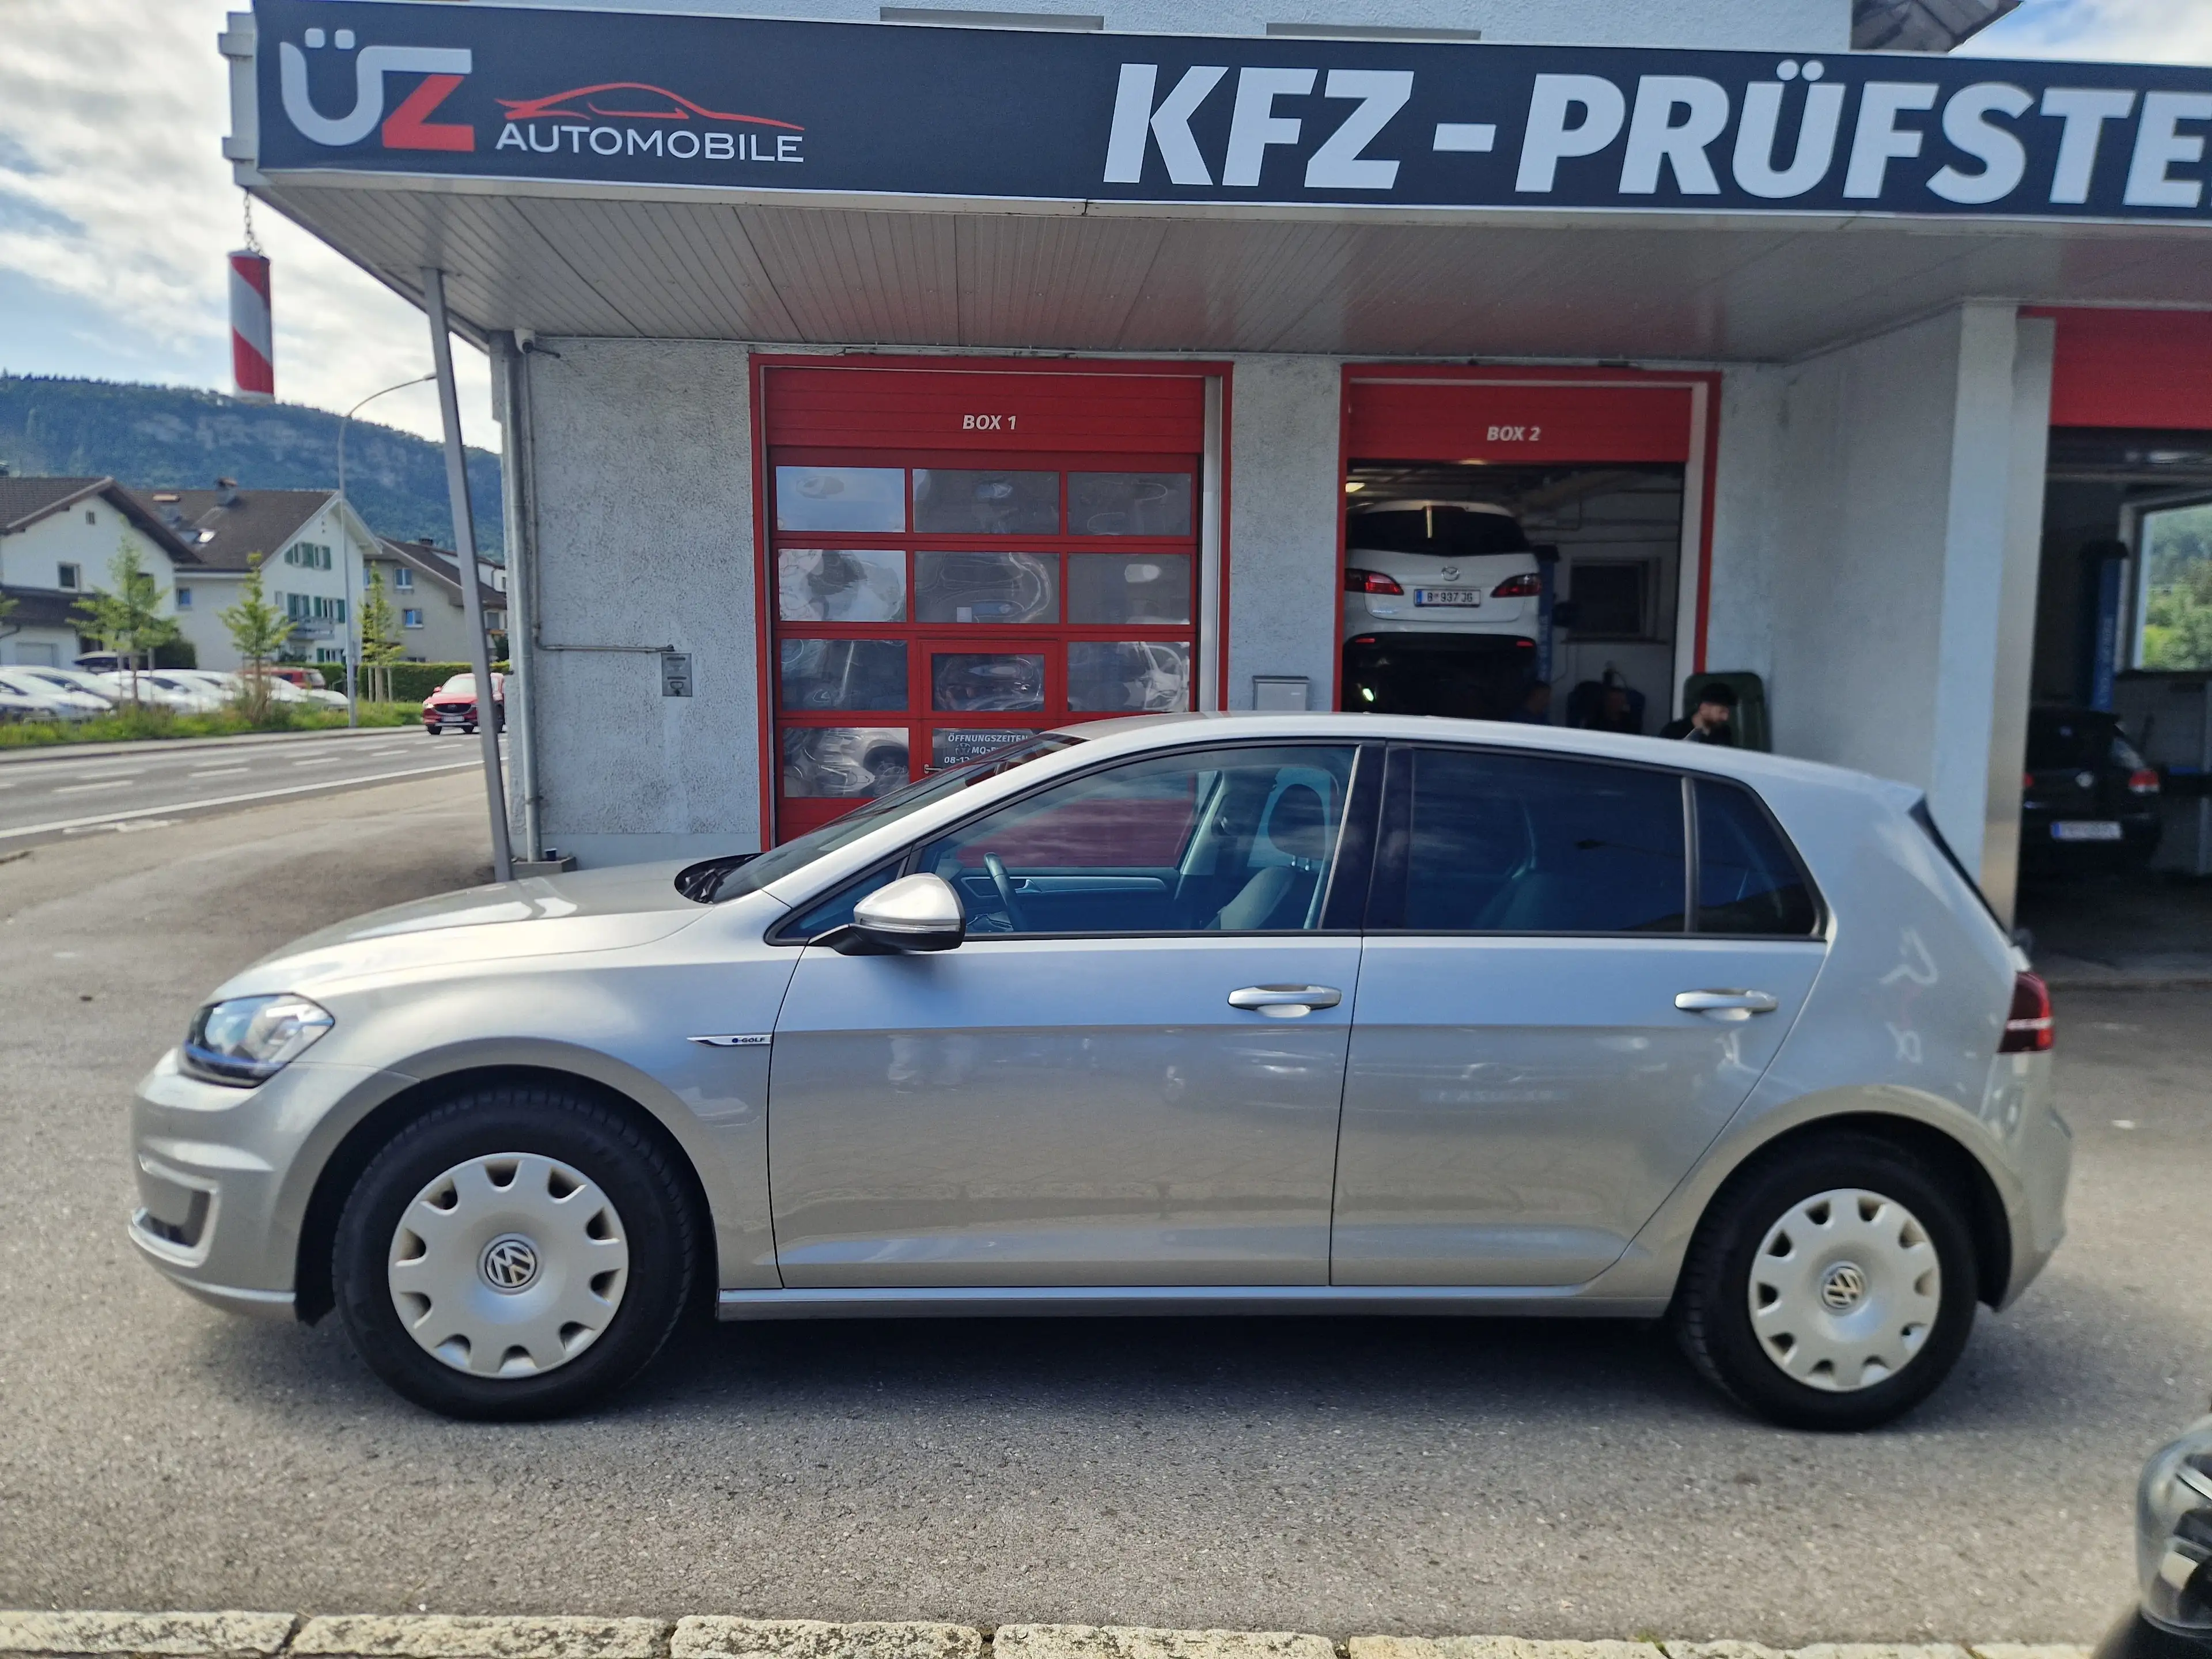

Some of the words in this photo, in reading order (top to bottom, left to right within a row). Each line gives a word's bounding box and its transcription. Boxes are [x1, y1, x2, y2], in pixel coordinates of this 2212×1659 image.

[1103, 63, 1415, 190] KFZ
[1514, 59, 2212, 209] PRÜFSTE
[495, 122, 805, 163] AUTOMOBILE
[963, 414, 1002, 430] BOX
[1007, 415, 1017, 430] 1
[1487, 426, 1525, 441] BOX
[1528, 426, 1541, 441] 2
[1441, 592, 1459, 603] 937
[948, 733, 1028, 743] ÖFFNUNGSZEITEN
